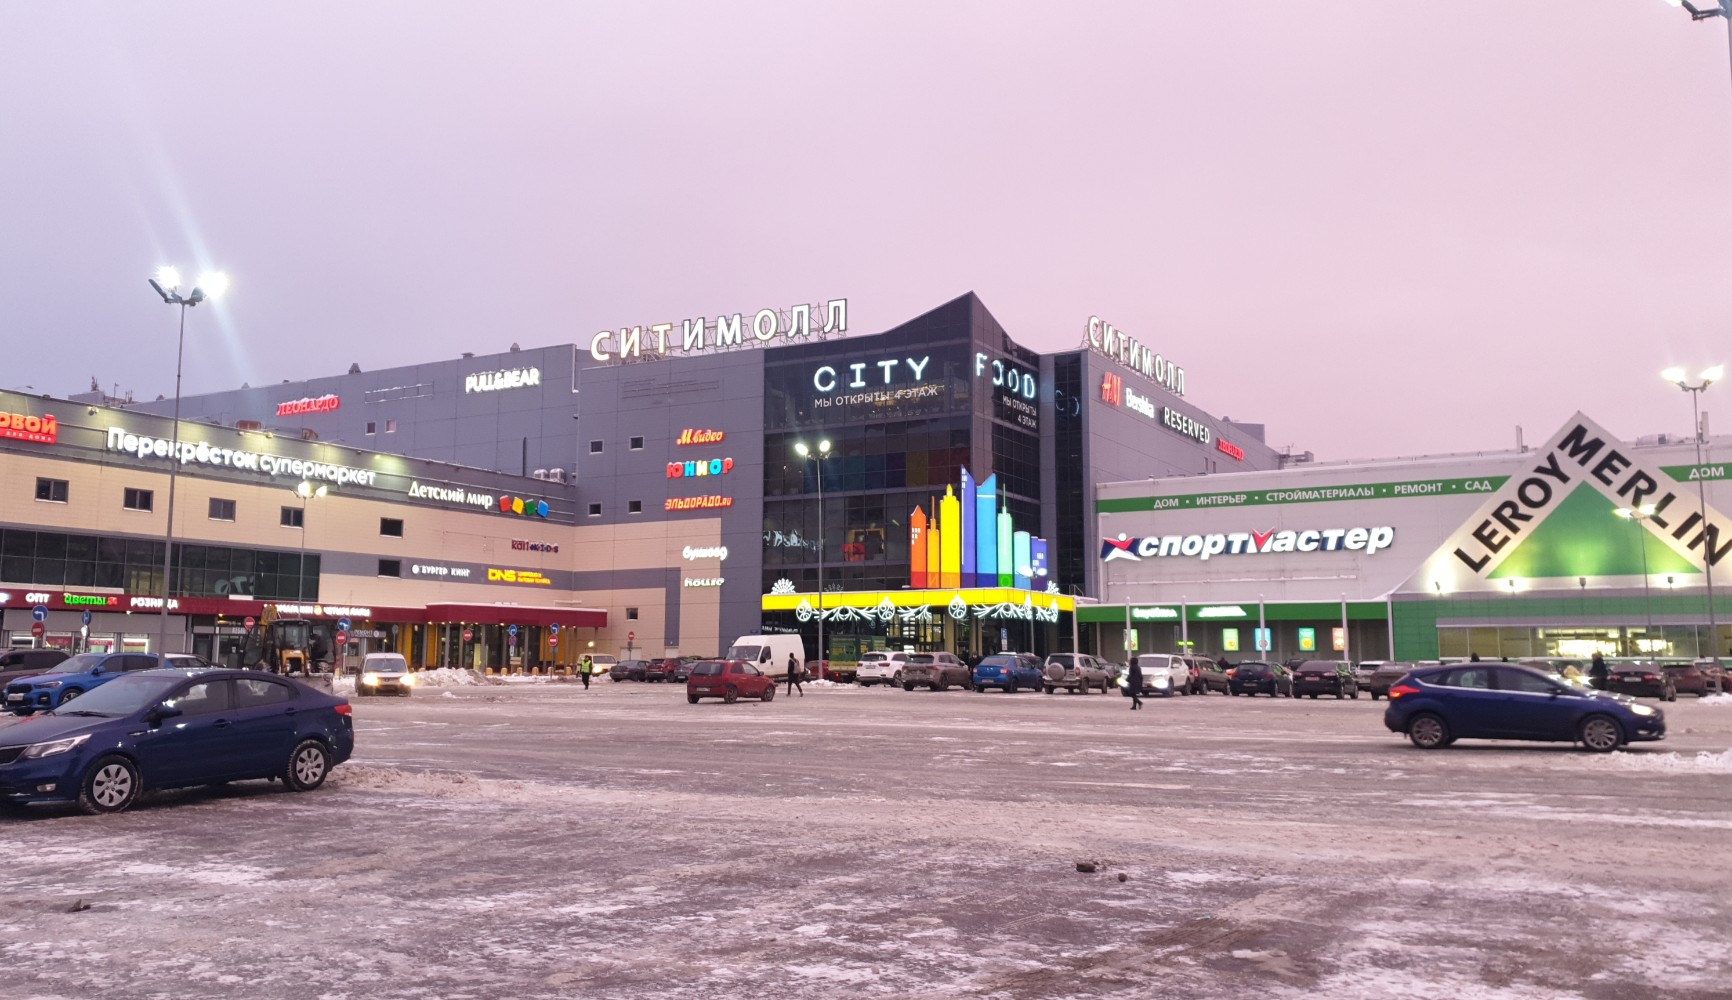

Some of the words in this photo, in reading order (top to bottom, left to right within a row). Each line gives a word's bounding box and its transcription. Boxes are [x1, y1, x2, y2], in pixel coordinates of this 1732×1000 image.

[590, 298, 848, 361] СИТИМОЛЛ
[1087, 315, 1185, 395] СИТИМОЛЛ
[465, 368, 541, 393] PULL&BEAR
[814, 355, 930, 392] CITY
[976, 352, 1036, 399] FOOD
[276, 395, 341, 416] ЛЕОНАРДО
[814, 398, 832, 408] МЫ
[835, 391, 890, 406] ОТКРЫТЫ
[894, 389, 901, 399] 4
[904, 386, 939, 399] ЭТАЖ
[1164, 406, 1210, 444] RESERVED
[260, 455, 376, 486] супермаркет
[667, 457, 735, 478] ЮНИОР
[1688, 466, 1725, 480] ДОМ
[408, 481, 464, 501] Детский
[466, 492, 494, 509] мир
[1153, 498, 1179, 509] ДОМ
[1196, 494, 1247, 506] ИНТЕРЬЕР
[1266, 486, 1375, 502] СТРОЙМАТЕРИАЛЫ
[1394, 482, 1443, 494] РЕМОНТ
[1464, 480, 1492, 491] САД
[1557, 423, 1732, 567] MERLIN
[1453, 451, 1571, 573] LEROY
[421, 565, 448, 575] БУРГЕР
[451, 567, 471, 577] КИНГ
[487, 567, 517, 583] DNS
[25, 592, 50, 603] ОПТ
